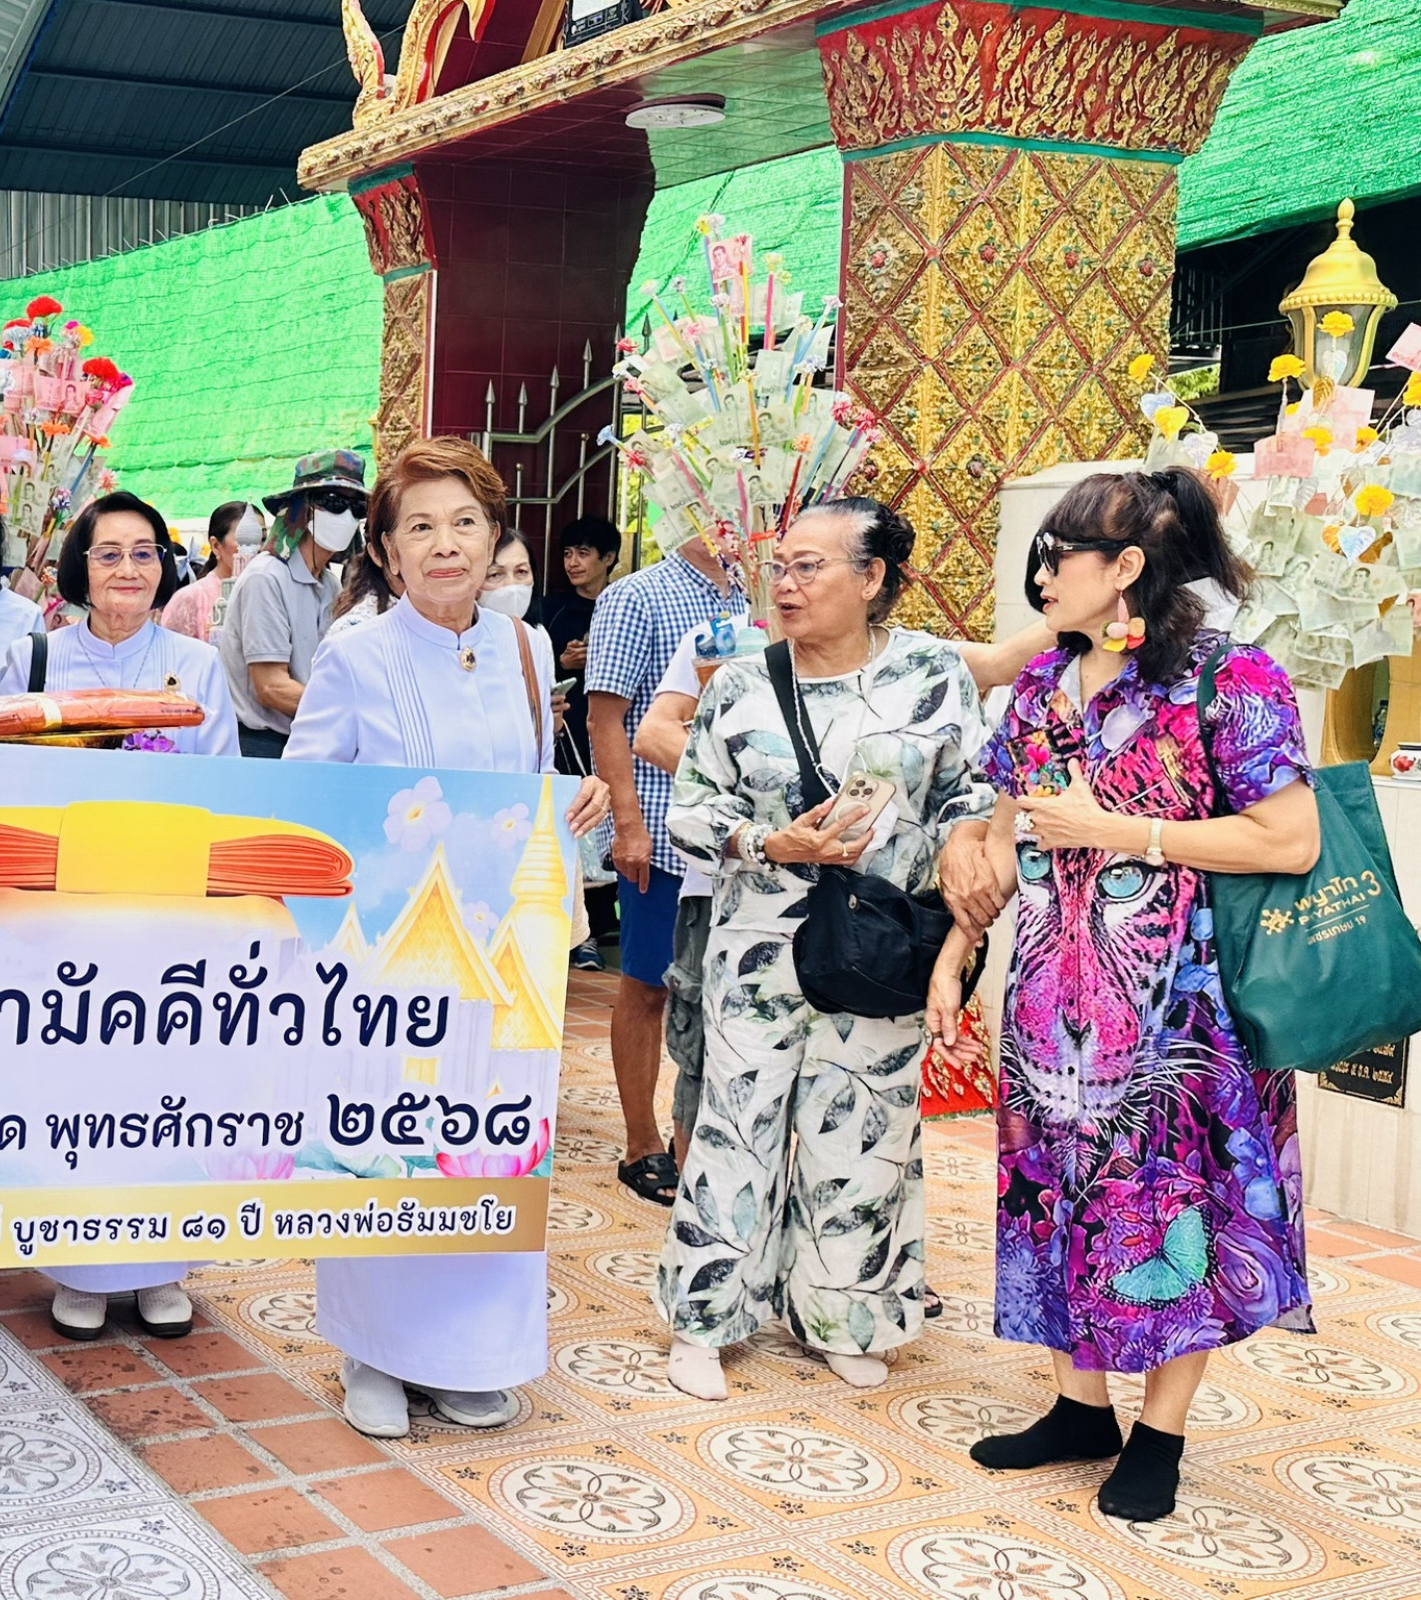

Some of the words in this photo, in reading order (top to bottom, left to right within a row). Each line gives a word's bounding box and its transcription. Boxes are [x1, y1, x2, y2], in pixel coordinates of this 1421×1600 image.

[1294, 876, 1358, 911] พญาไท
[1360, 870, 1381, 896] 3
[45, 1095, 304, 1170] พุทธศักราช
[327, 1092, 532, 1146] ๒๕๖๘
[13, 1217, 167, 1256] บูชาธรรม
[182, 1215, 226, 1239] ๘๑
[240, 1202, 262, 1236] ปี
[275, 1199, 513, 1236] หลวงพ่อธัมมชโย
